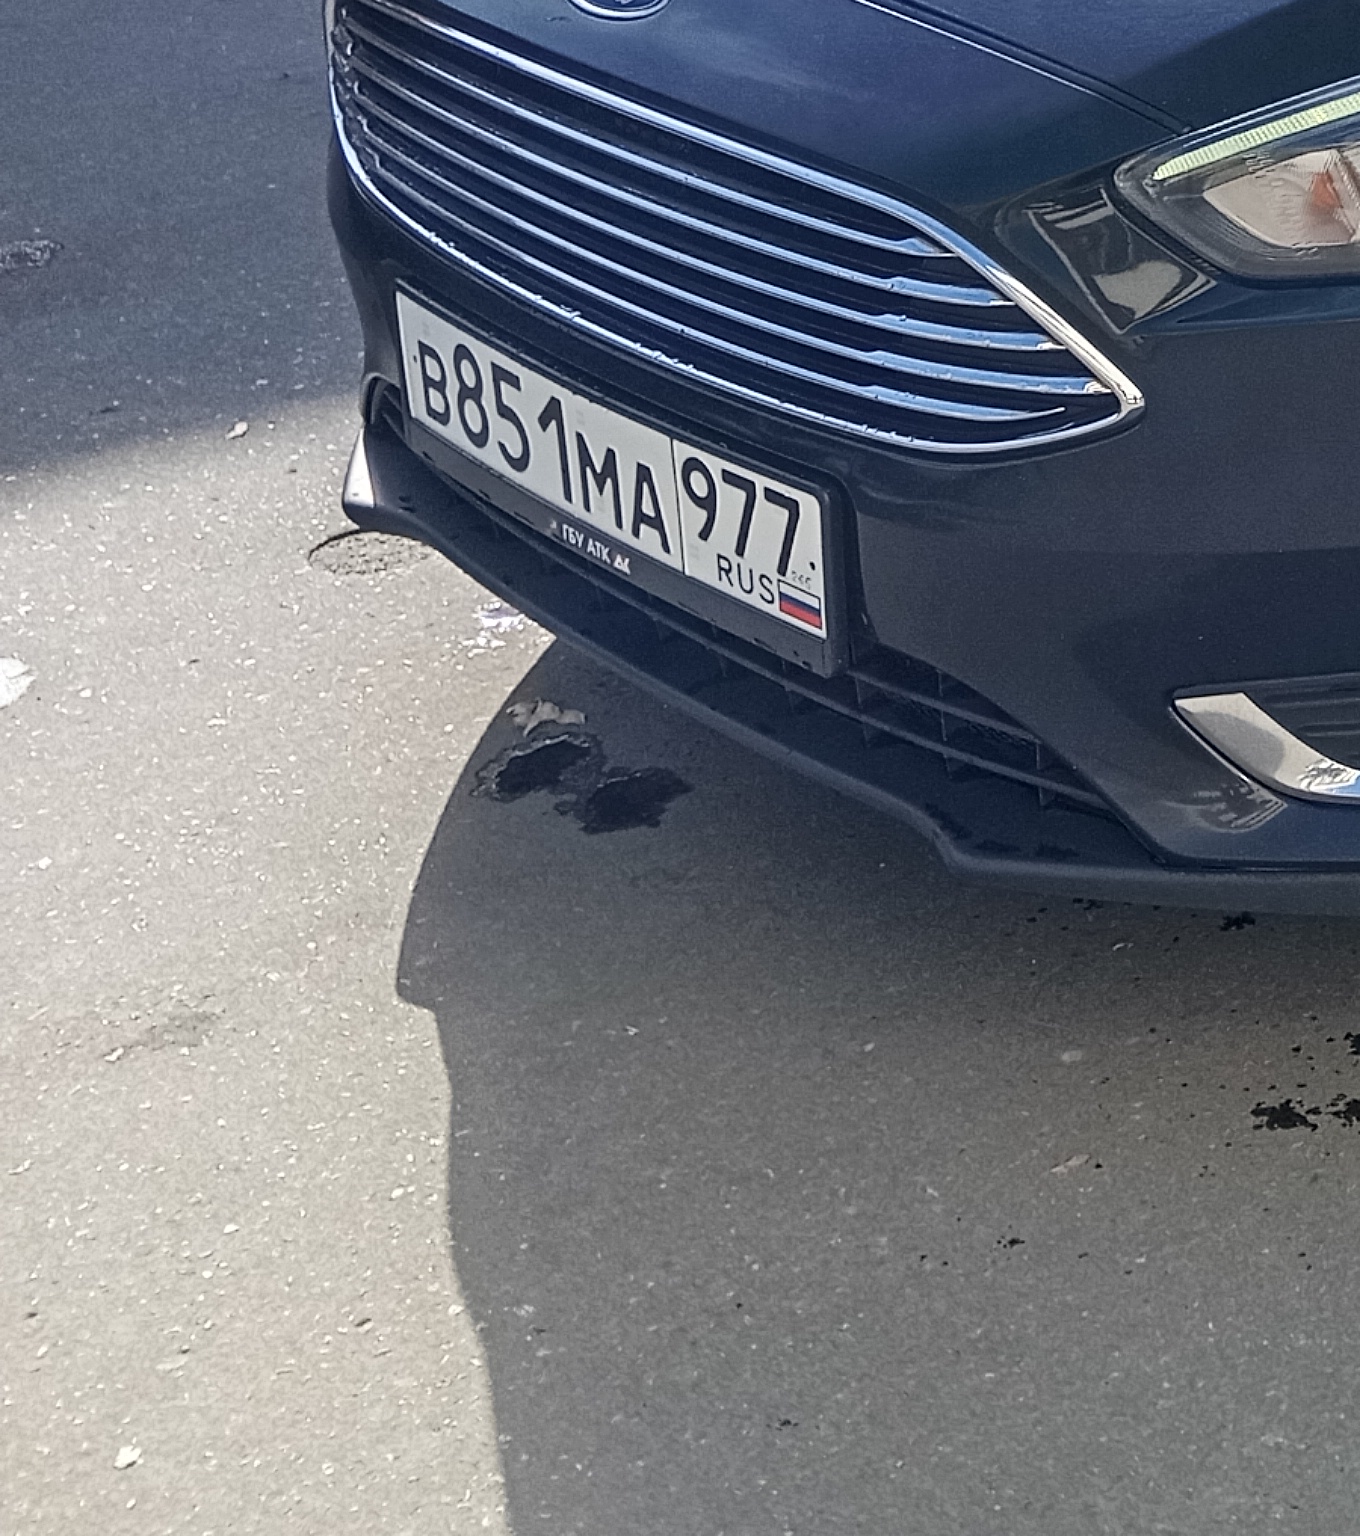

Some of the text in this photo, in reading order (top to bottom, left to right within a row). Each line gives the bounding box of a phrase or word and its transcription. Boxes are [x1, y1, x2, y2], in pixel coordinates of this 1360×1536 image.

[561, 523, 585, 549] ГБУ
[681, 455, 801, 578] 977
[716, 552, 775, 605] RUS
